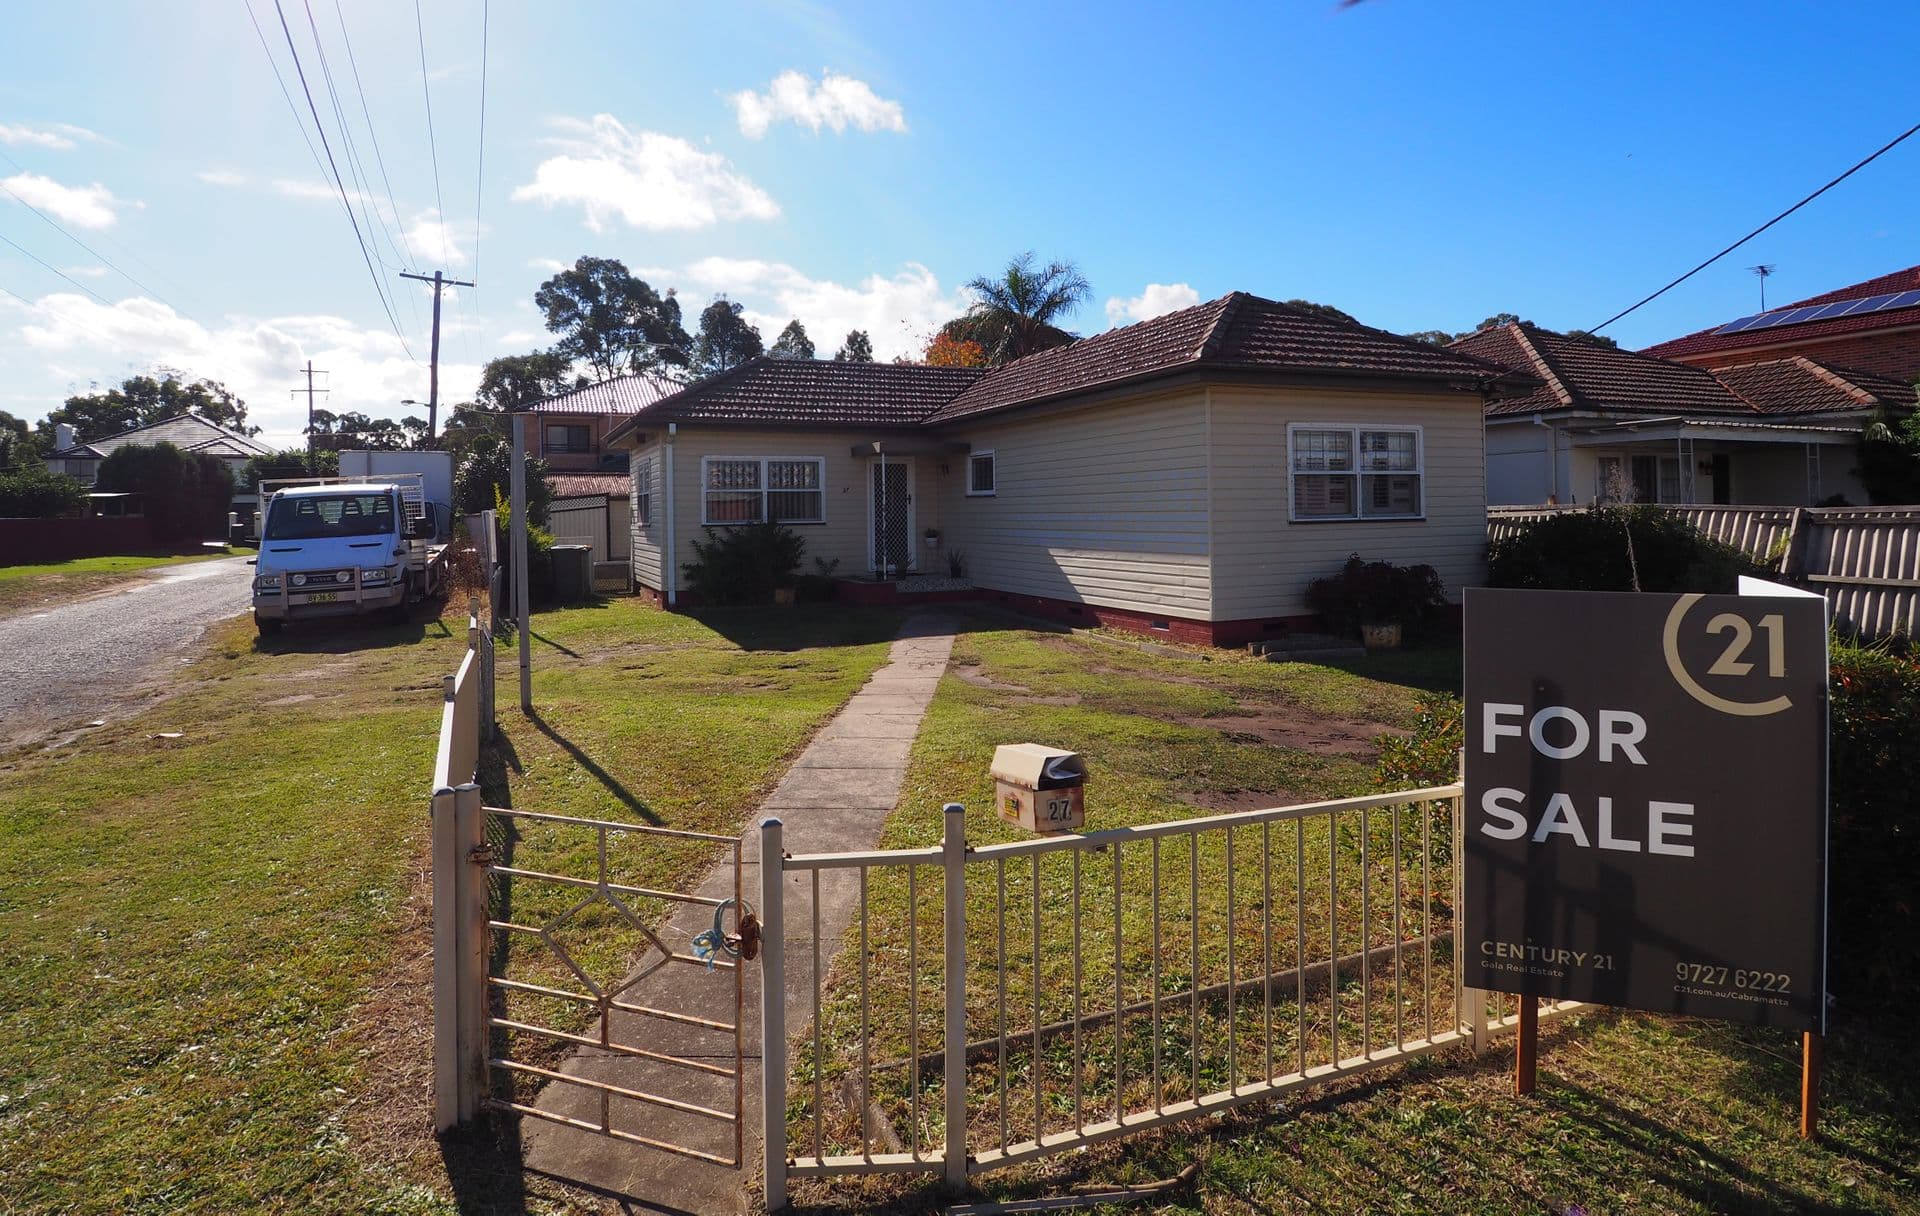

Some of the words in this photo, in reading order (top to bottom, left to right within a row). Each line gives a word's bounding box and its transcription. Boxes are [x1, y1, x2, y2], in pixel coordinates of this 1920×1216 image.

[1483, 702, 1648, 765] FOR
[1049, 800, 1070, 821] 27
[1480, 787, 1694, 857] SALE
[1480, 941, 1587, 967] CENTURY
[1480, 960, 1504, 970] Gala
[1506, 963, 1528, 973] Real
[1530, 966, 1565, 978] Estate
[1676, 962, 1728, 985] 9727
[1735, 969, 1792, 994] 6222
